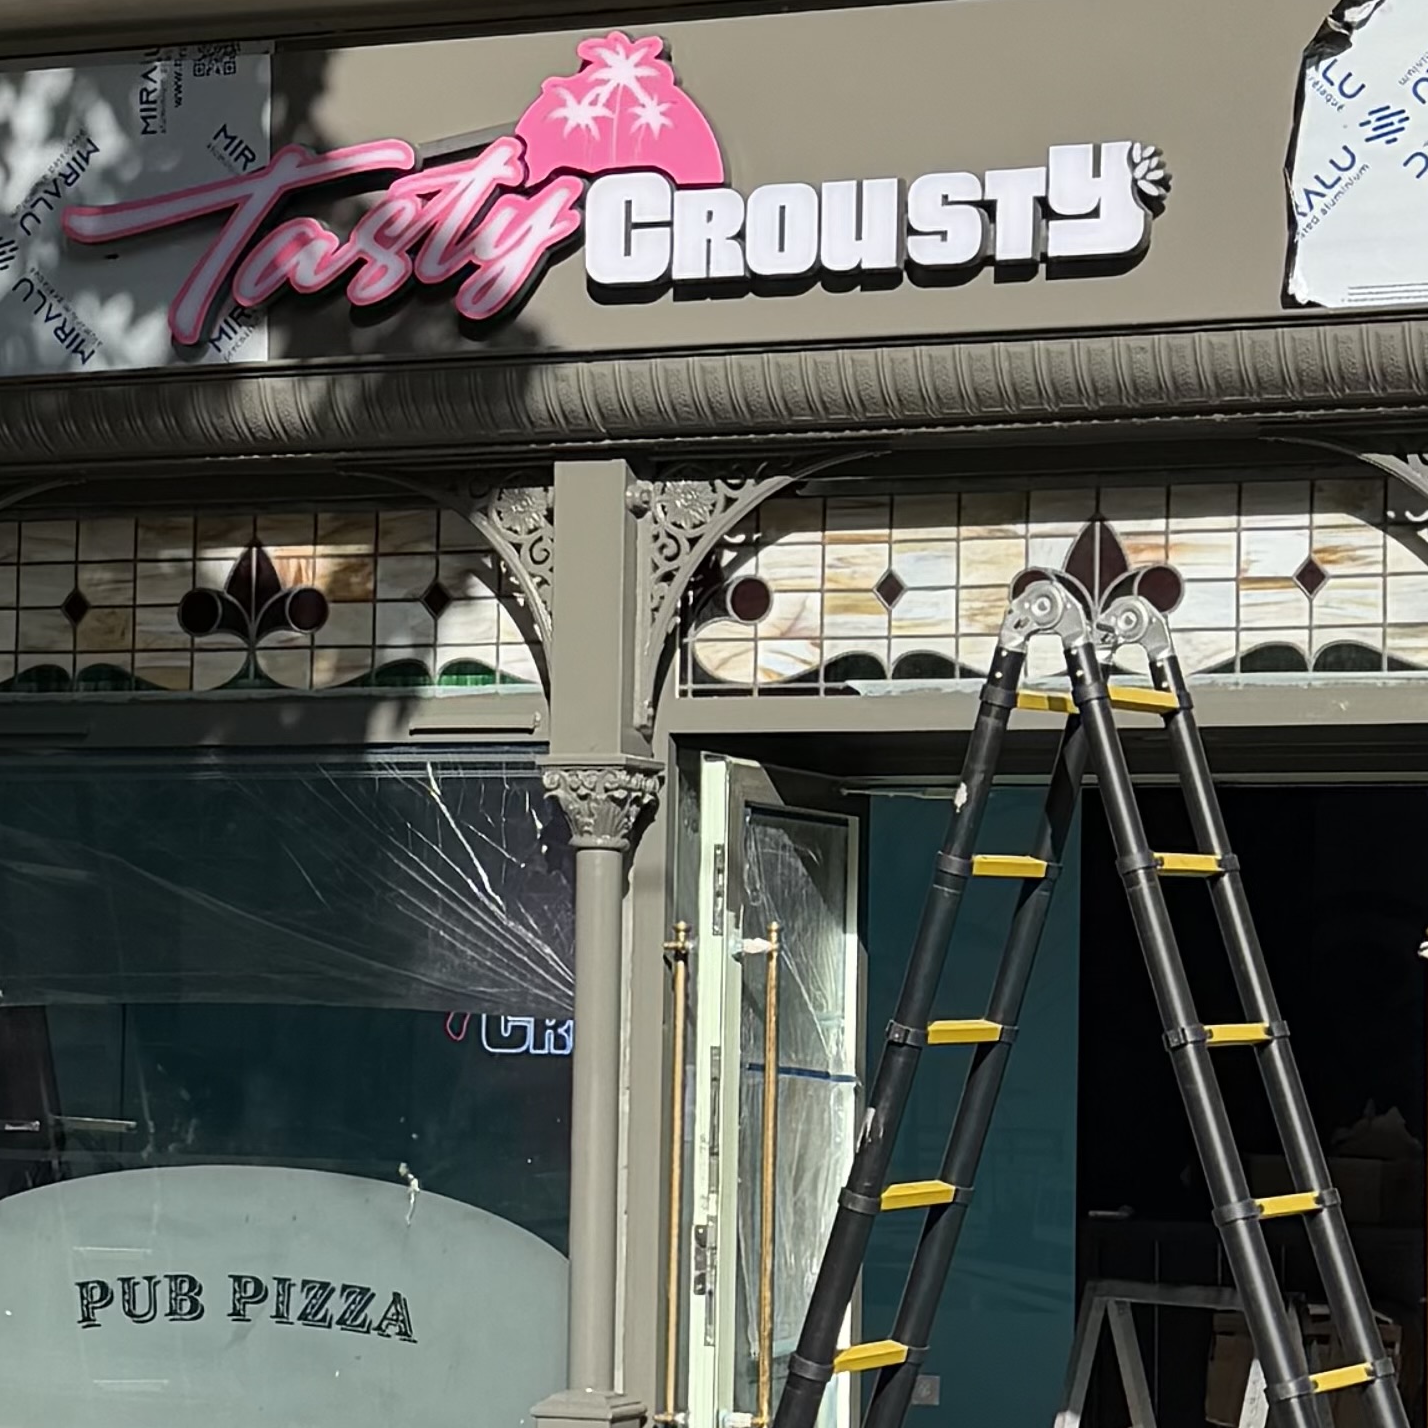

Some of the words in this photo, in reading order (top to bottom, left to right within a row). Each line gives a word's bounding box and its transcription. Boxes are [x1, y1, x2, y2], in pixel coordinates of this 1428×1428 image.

[20, 137, 100, 236] MIRALU
[61, 136, 585, 346] Tasty
[12, 277, 95, 365] MIRALU
[75, 1273, 205, 1329] PUB
[226, 1274, 418, 1344] PIZZA
